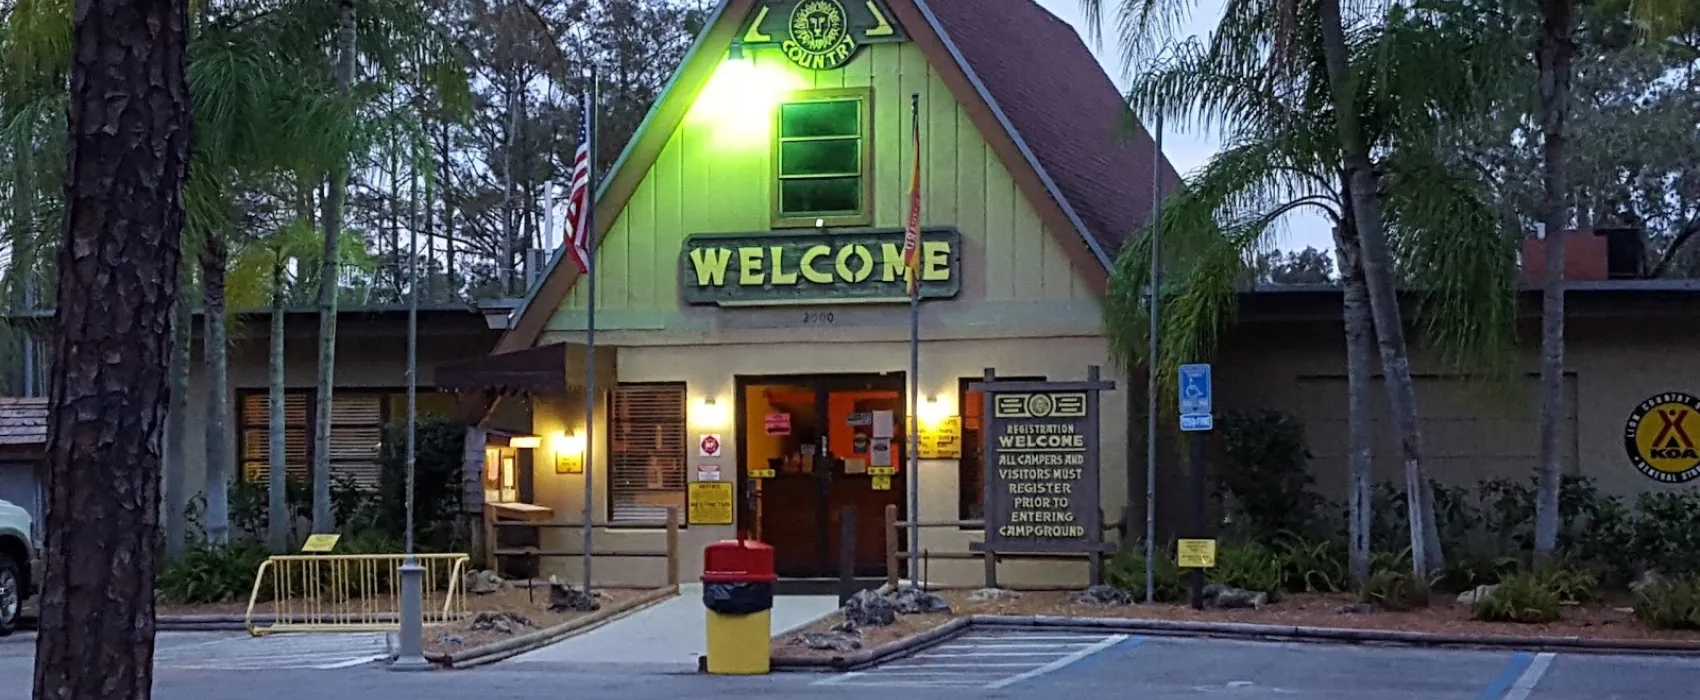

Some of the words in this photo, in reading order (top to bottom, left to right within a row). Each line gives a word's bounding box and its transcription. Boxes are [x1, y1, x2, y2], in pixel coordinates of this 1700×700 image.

[783, 33, 855, 69] COUNTRY
[690, 241, 951, 286] WELCOME
[1641, 394, 1690, 411] COUNTRY
[1006, 424, 1074, 435] REGISTRATION
[999, 435, 1084, 447] WELCOME
[1650, 448, 1699, 459] KOA
[999, 454, 1017, 465] ALL
[1017, 454, 1063, 466] CAMPERS
[1064, 454, 1085, 465] AND
[999, 469, 1051, 480] VISITORS
[1053, 469, 1083, 480] MUST
[1638, 462, 1677, 482] GENERAL
[1008, 483, 1071, 494] REGISTER
[1014, 497, 1051, 508] PRIOR
[1052, 497, 1069, 508] TO
[1011, 511, 1074, 522] ENTERING
[999, 525, 1085, 537] CAMPGROUND
